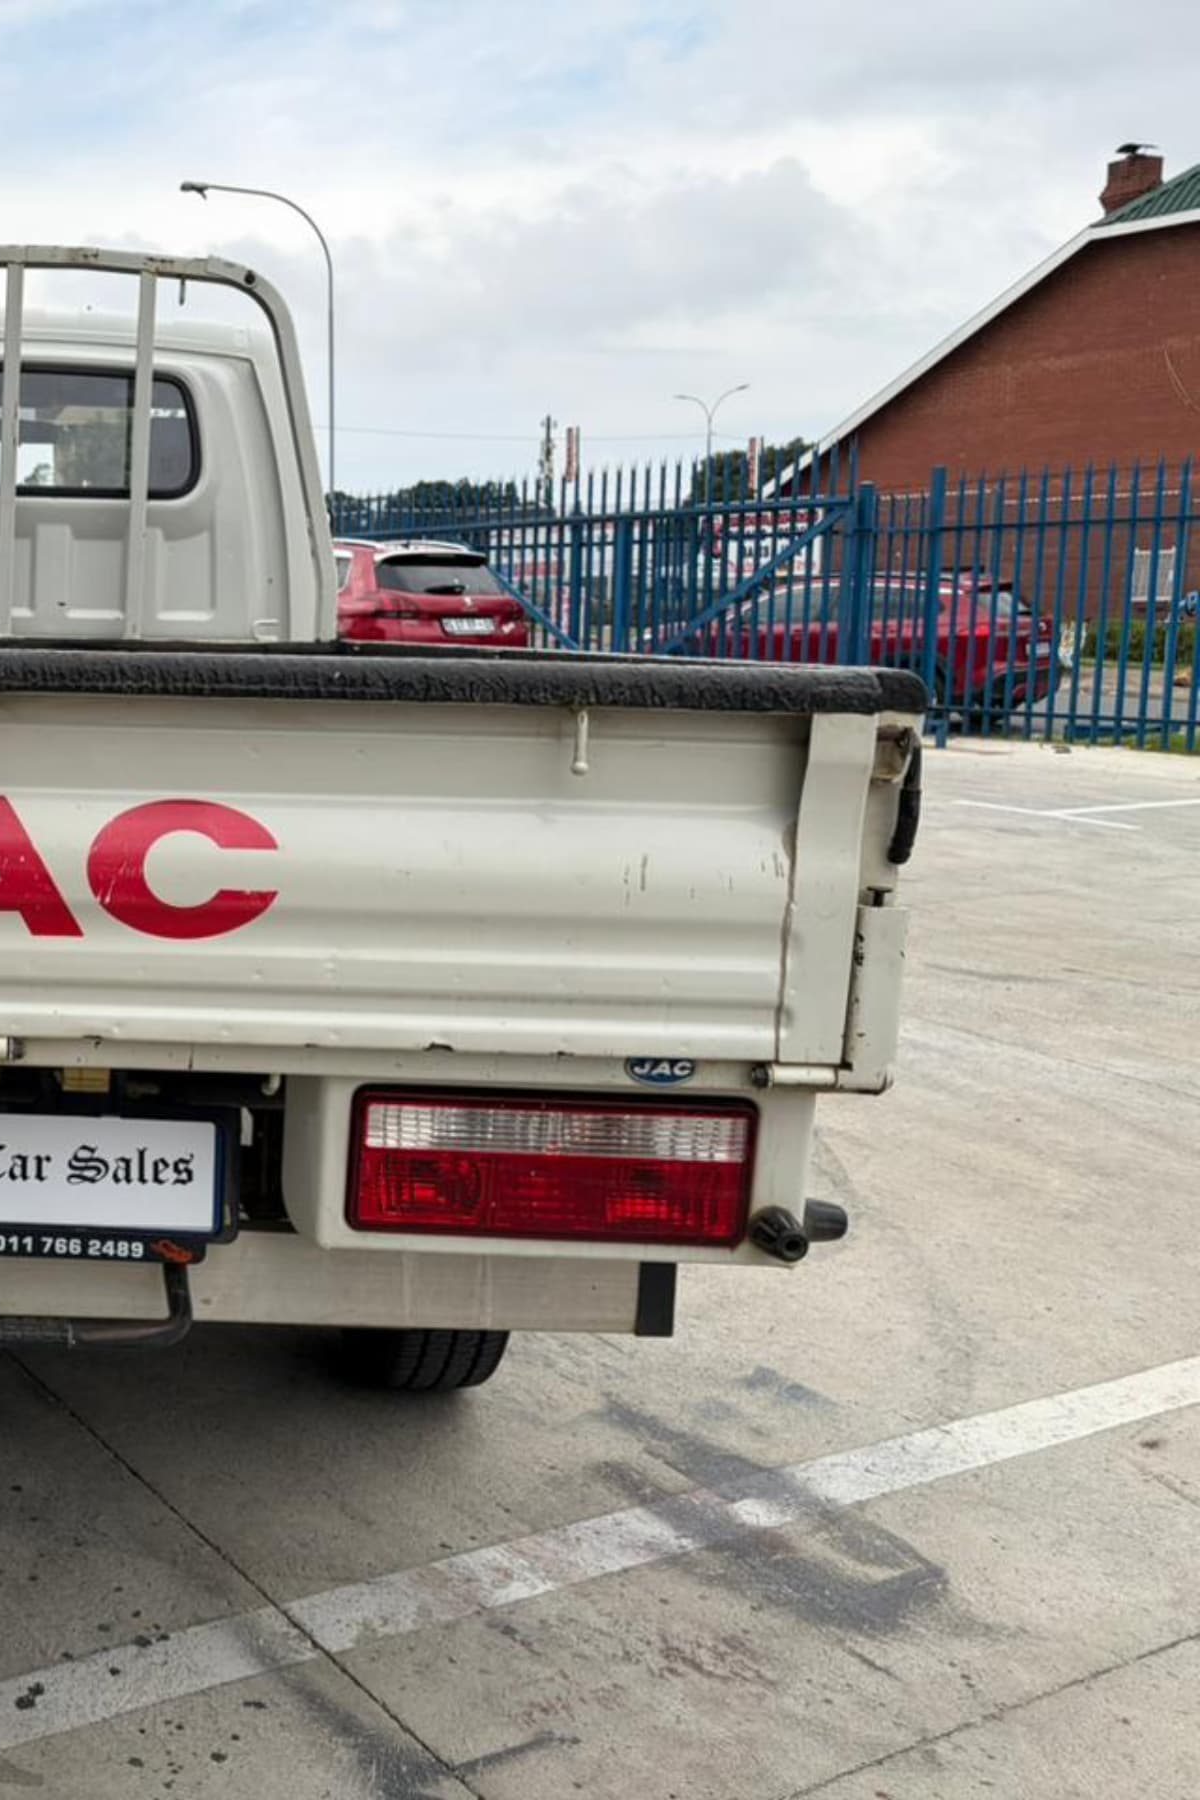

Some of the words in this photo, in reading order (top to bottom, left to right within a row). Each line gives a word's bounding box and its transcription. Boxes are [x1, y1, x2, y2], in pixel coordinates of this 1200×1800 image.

[632, 1060, 693, 1076] JAC
[66, 1144, 194, 1186] Sales
[41, 1237, 82, 1255] 766
[87, 1239, 144, 1258] 2489
